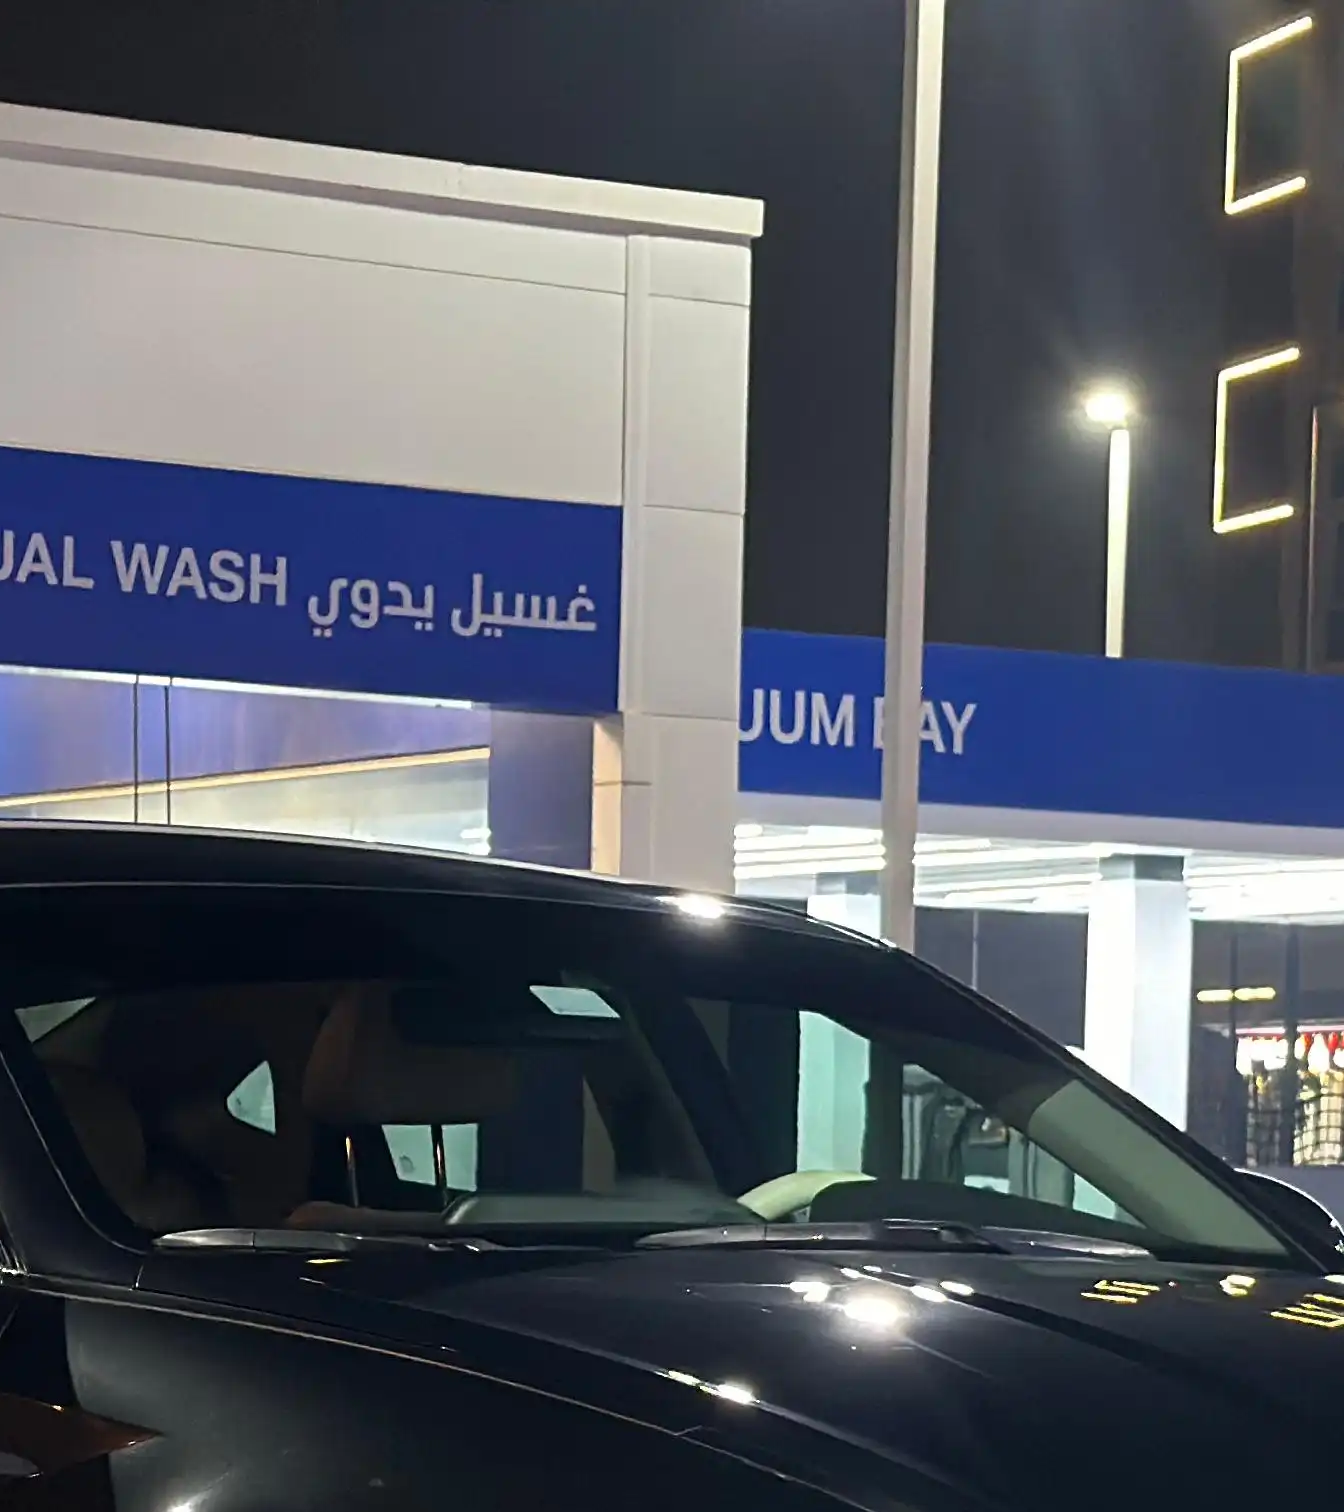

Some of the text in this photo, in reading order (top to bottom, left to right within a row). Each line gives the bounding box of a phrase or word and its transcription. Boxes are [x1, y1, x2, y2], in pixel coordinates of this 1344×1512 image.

[111, 539, 288, 606] WASH
[307, 572, 597, 637] غسيل يدوي
